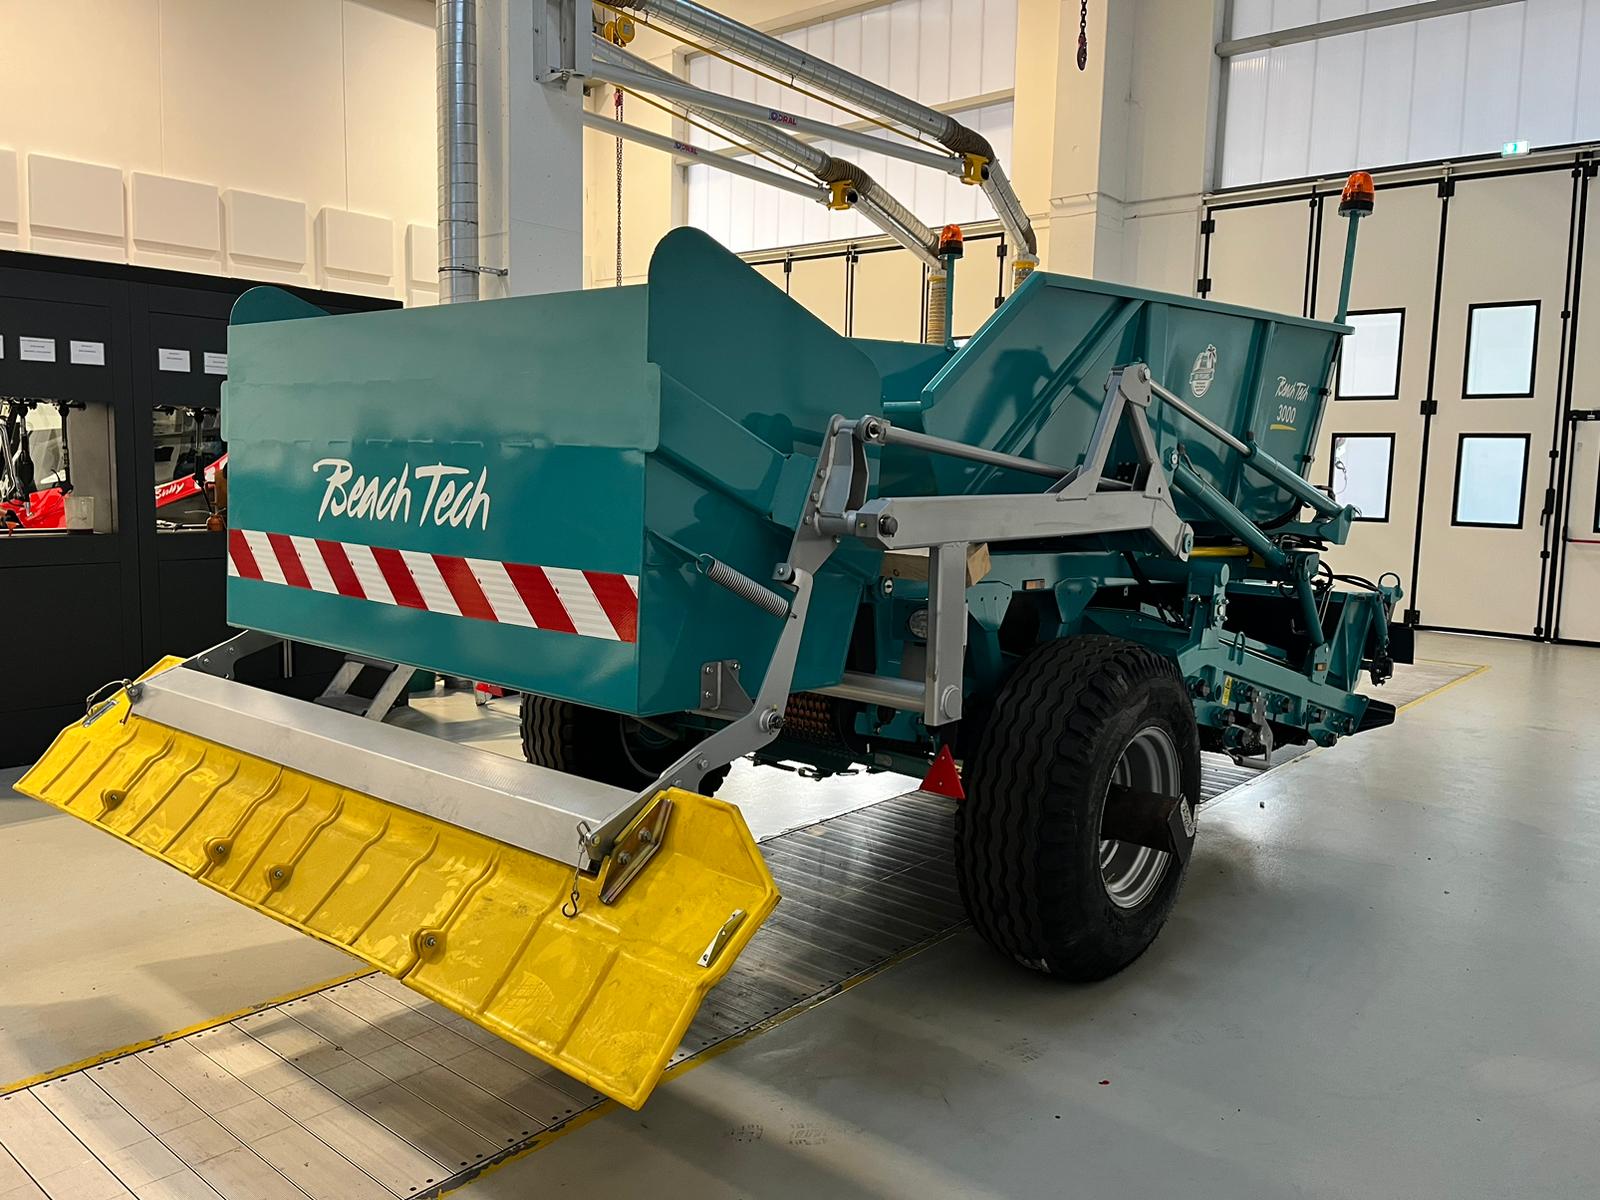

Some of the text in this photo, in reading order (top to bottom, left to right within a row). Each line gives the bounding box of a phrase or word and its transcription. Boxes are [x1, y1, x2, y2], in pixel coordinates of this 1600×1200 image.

[1276, 404, 1296, 423] 3000
[312, 458, 491, 531] Beach Tech
